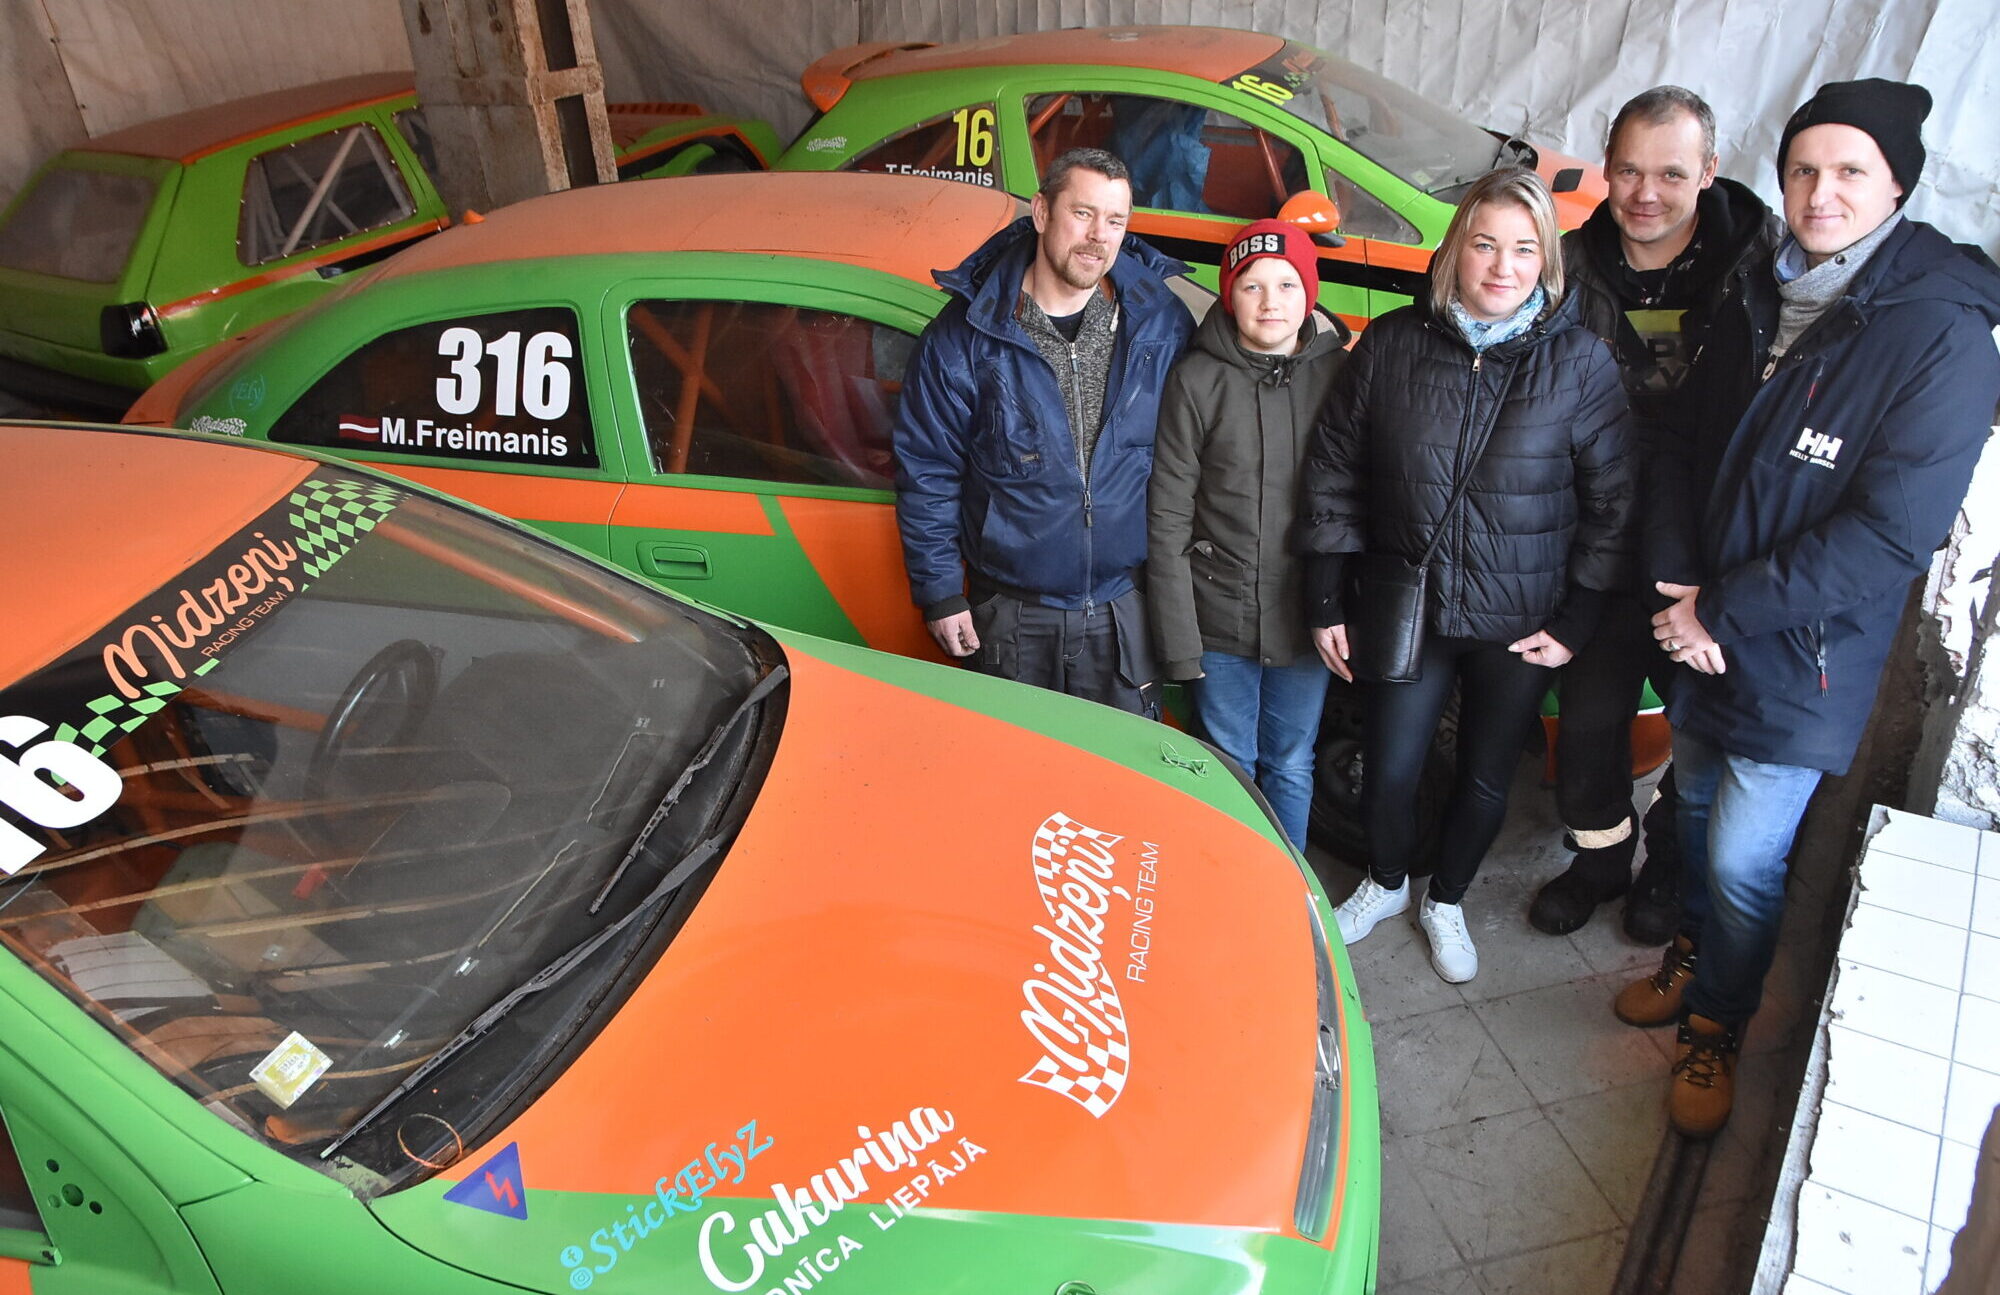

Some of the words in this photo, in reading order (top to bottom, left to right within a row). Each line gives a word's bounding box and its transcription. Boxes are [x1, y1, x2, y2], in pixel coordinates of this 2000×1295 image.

[1232, 74, 1295, 106] 16
[953, 108, 995, 167] 16
[1229, 234, 1279, 270] BOSS
[436, 327, 573, 420] 316
[381, 416, 569, 457] M.Freimanis
[1795, 427, 1843, 461] HH
[103, 532, 298, 699] Midzeņi
[201, 617, 255, 657] RACING
[247, 591, 288, 618] TEAM
[1137, 841, 1160, 893] TEAM
[1126, 897, 1154, 983] RACING
[590, 1119, 774, 1274] StickElyZ
[698, 1107, 954, 1291] Cukuriņa
[765, 1235, 864, 1295] NĪCA
[868, 1136, 988, 1231] LIEPĀJĀ
